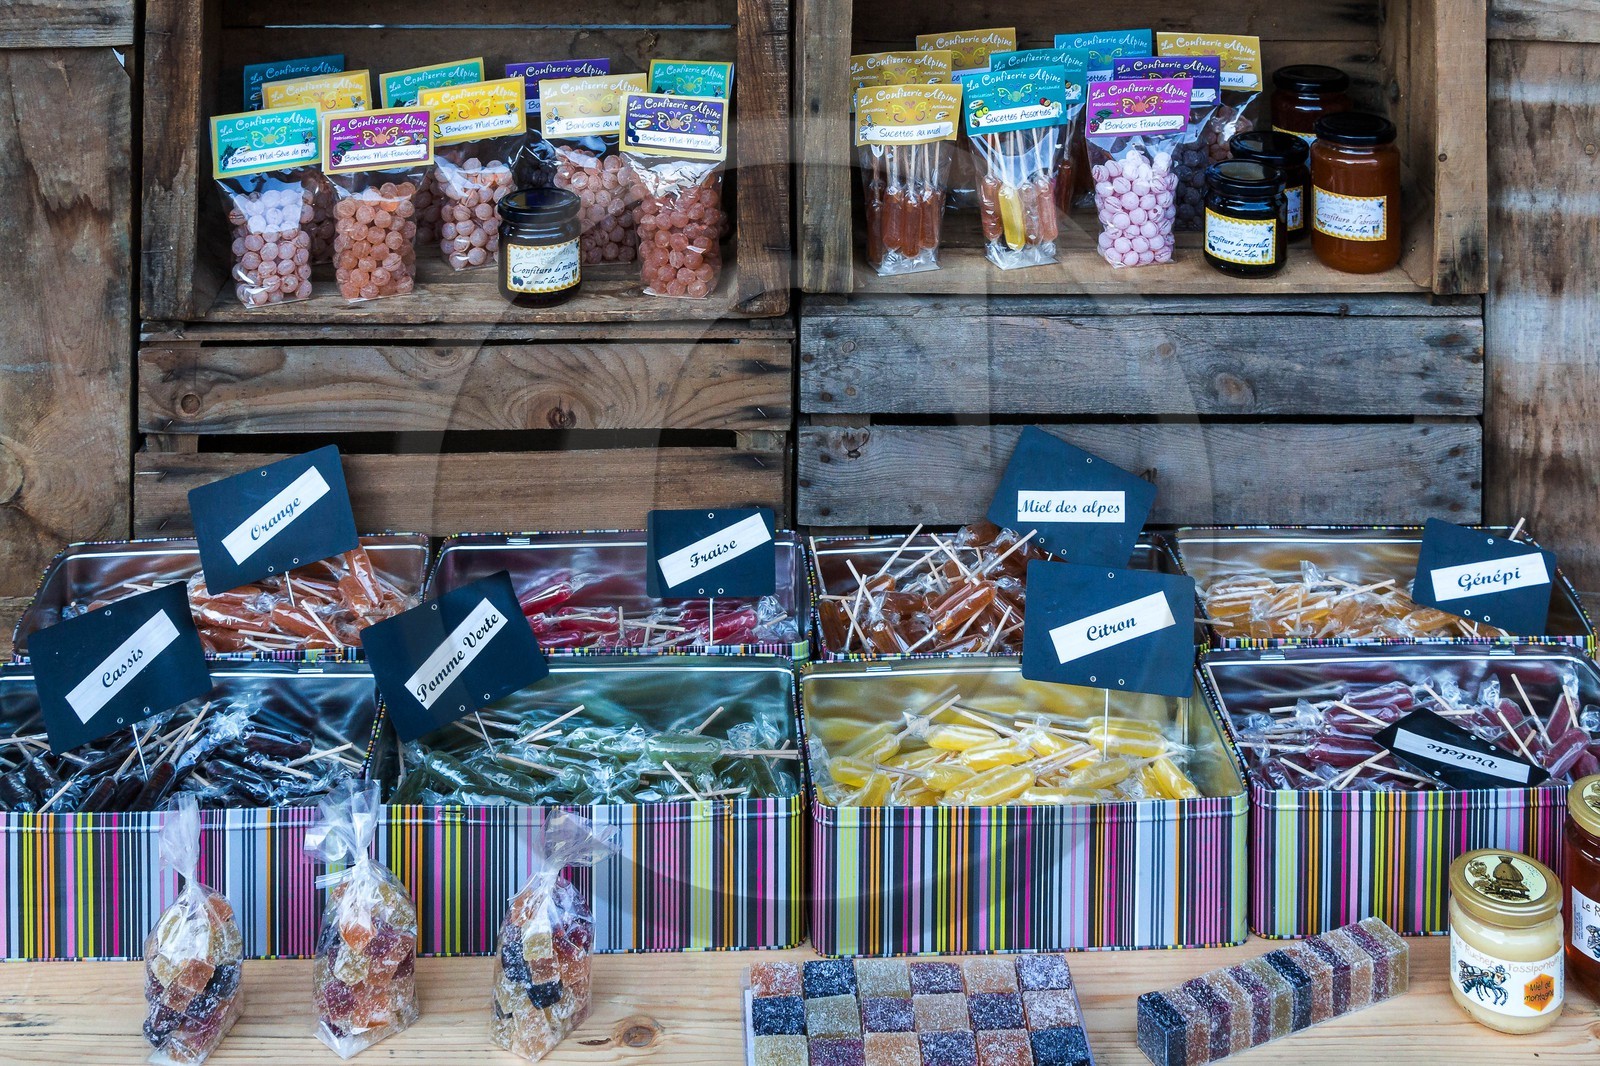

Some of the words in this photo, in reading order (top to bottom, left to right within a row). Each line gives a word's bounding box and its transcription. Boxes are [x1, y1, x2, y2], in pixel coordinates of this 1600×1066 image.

[936, 34, 980, 49] Confiserie
[981, 33, 1012, 47] Alpine
[1073, 35, 1117, 48] Confiserie
[1118, 34, 1148, 48] Alpine
[1161, 40, 1174, 51] La
[1176, 37, 1222, 48] Confiserie
[1223, 39, 1257, 55] Alpine
[525, 63, 572, 77] Confiserie
[574, 62, 607, 76] Alpine
[850, 62, 864, 74] La
[866, 54, 912, 69] Confiserie
[914, 54, 948, 69] Alpine
[994, 61, 1006, 71] La
[1008, 53, 1050, 66] Confiserie
[1052, 52, 1083, 67] Alpine
[1117, 64, 1131, 74] La
[1133, 59, 1181, 72] Confiserie
[1183, 60, 1217, 74] Alpine
[249, 72, 263, 85] La
[265, 64, 310, 79] Confiserie
[389, 82, 401, 92] La
[403, 71, 446, 86] Confiserie
[447, 66, 478, 80] Alpine
[655, 68, 664, 78] La
[666, 64, 700, 75] Confiserie
[701, 66, 725, 80] Alpine
[966, 80, 980, 92] La
[981, 71, 1027, 86] Confiserie
[1028, 68, 1061, 83] Alpine
[426, 98, 439, 106] La
[441, 89, 485, 103] Confiserie
[487, 86, 518, 98] Alpine
[544, 87, 558, 99] La
[560, 80, 608, 95] Confiserie
[610, 80, 643, 93] Alpine
[860, 95, 873, 107] La
[875, 87, 922, 102] Confiserie
[923, 88, 957, 103] Alpine
[1092, 90, 1106, 100] La
[1108, 83, 1154, 96] Confiserie
[1155, 82, 1188, 98] Alpine
[629, 100, 642, 111] La
[644, 97, 689, 110] Confiserie
[690, 102, 721, 119] Alpine
[985, 113, 1018, 124] Sucettes
[1020, 108, 1052, 120] Assorties
[220, 125, 233, 138] La
[235, 115, 282, 131] Confiserie
[283, 112, 315, 127] Alpine
[332, 123, 346, 135] La
[348, 115, 394, 130] Confiserie
[395, 113, 428, 128] Alpine
[445, 123, 474, 134] Bonbons
[565, 120, 600, 131] Bonbons
[879, 128, 914, 138] Sucettes
[916, 129, 926, 137] au
[1104, 121, 1138, 131] Bonbons
[1140, 118, 1178, 129] Framboise
[1317, 206, 1350, 223] Confiture
[1207, 230, 1234, 245] Confiture
[1243, 238, 1271, 253] myrtilles
[512, 262, 552, 279] Confiture
[1018, 499, 1052, 513] Miel
[1055, 500, 1077, 514] des
[1082, 500, 1120, 517] alpes
[250, 497, 302, 541] Orange
[689, 539, 738, 569] Fraise
[1457, 567, 1522, 592] Génépi
[1086, 616, 1137, 642] Citron
[415, 648, 466, 703] Pomme
[462, 612, 500, 648] Verte
[101, 647, 144, 688] Cassis
[1426, 742, 1498, 770] Violette
[1581, 898, 1591, 913] Le
[1524, 988, 1554, 1002] montagne
[1529, 982, 1543, 992] Miel
